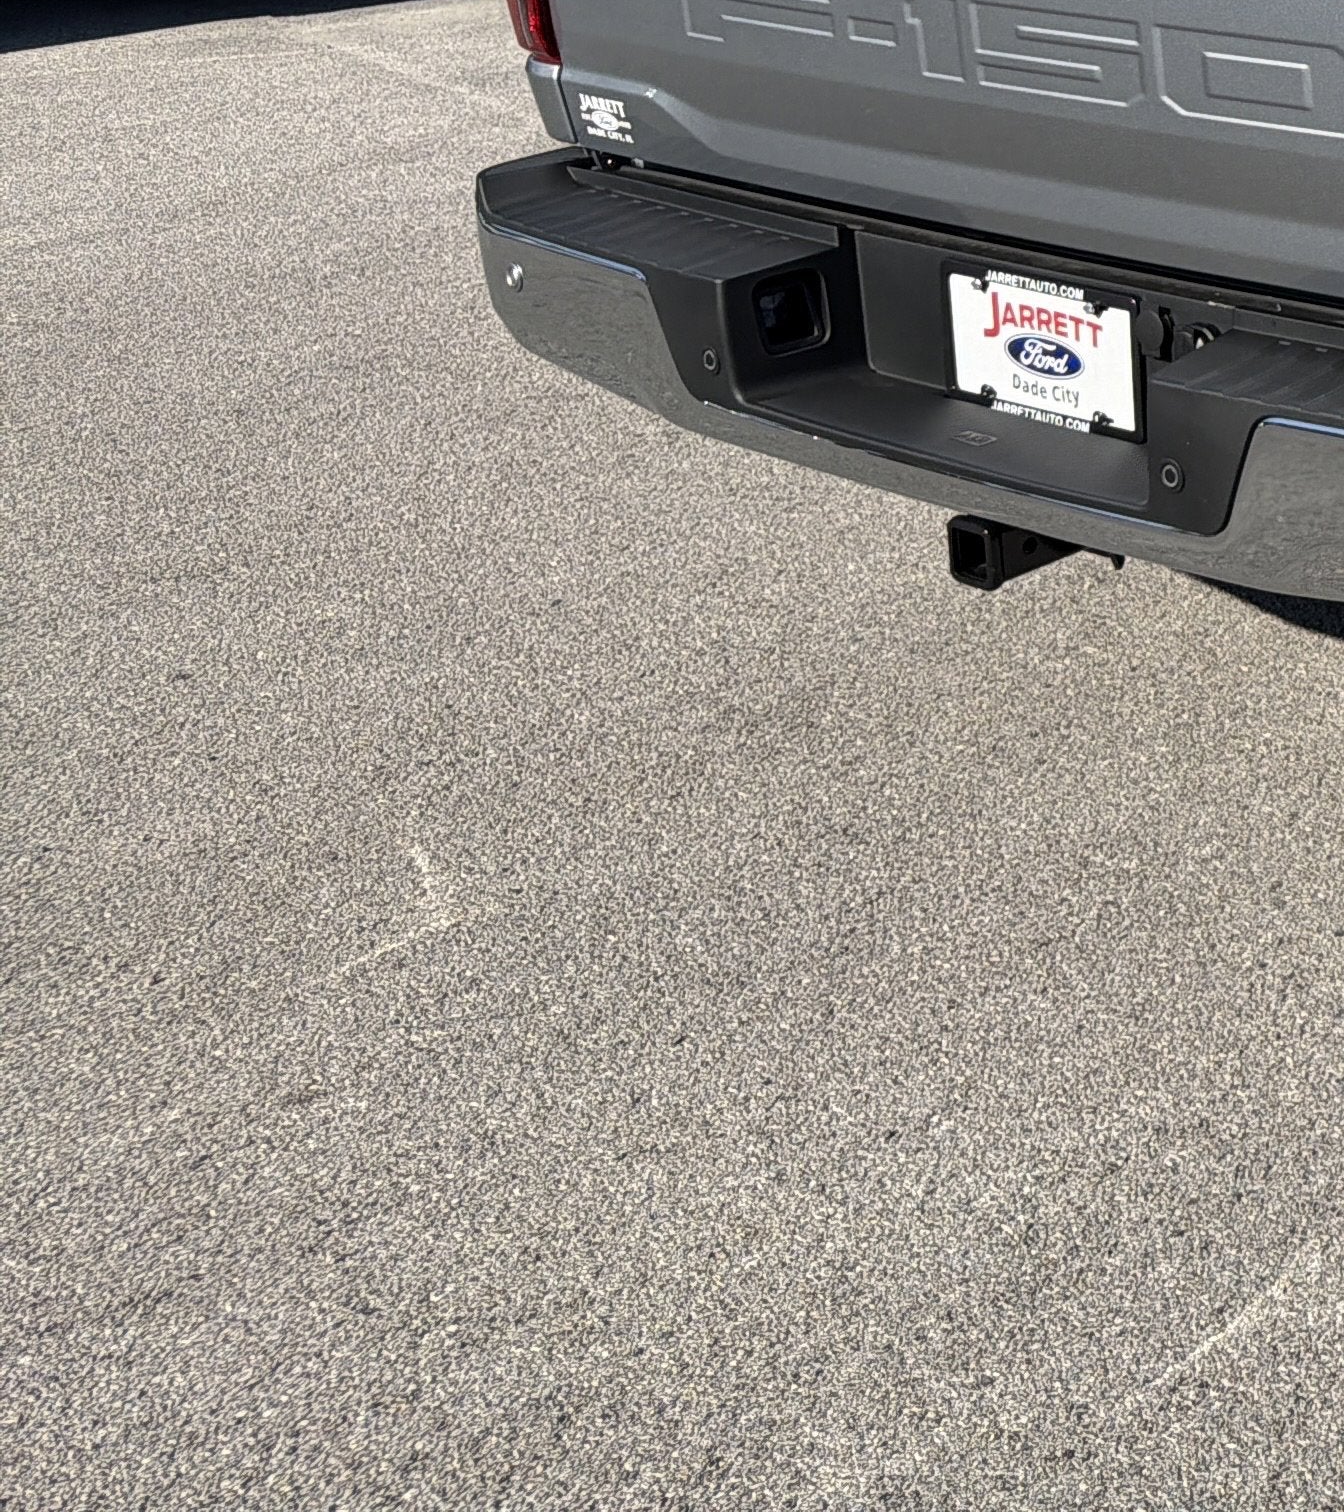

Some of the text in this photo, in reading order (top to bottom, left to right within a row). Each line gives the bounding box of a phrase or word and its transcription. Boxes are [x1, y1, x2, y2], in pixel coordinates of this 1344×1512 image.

[578, 92, 626, 118] JARRETT
[985, 269, 1084, 301] JARRETTAUTO.COM
[983, 291, 1104, 349] JARRETT
[1019, 338, 1069, 375] Ford
[1012, 373, 1080, 409] Dade City
